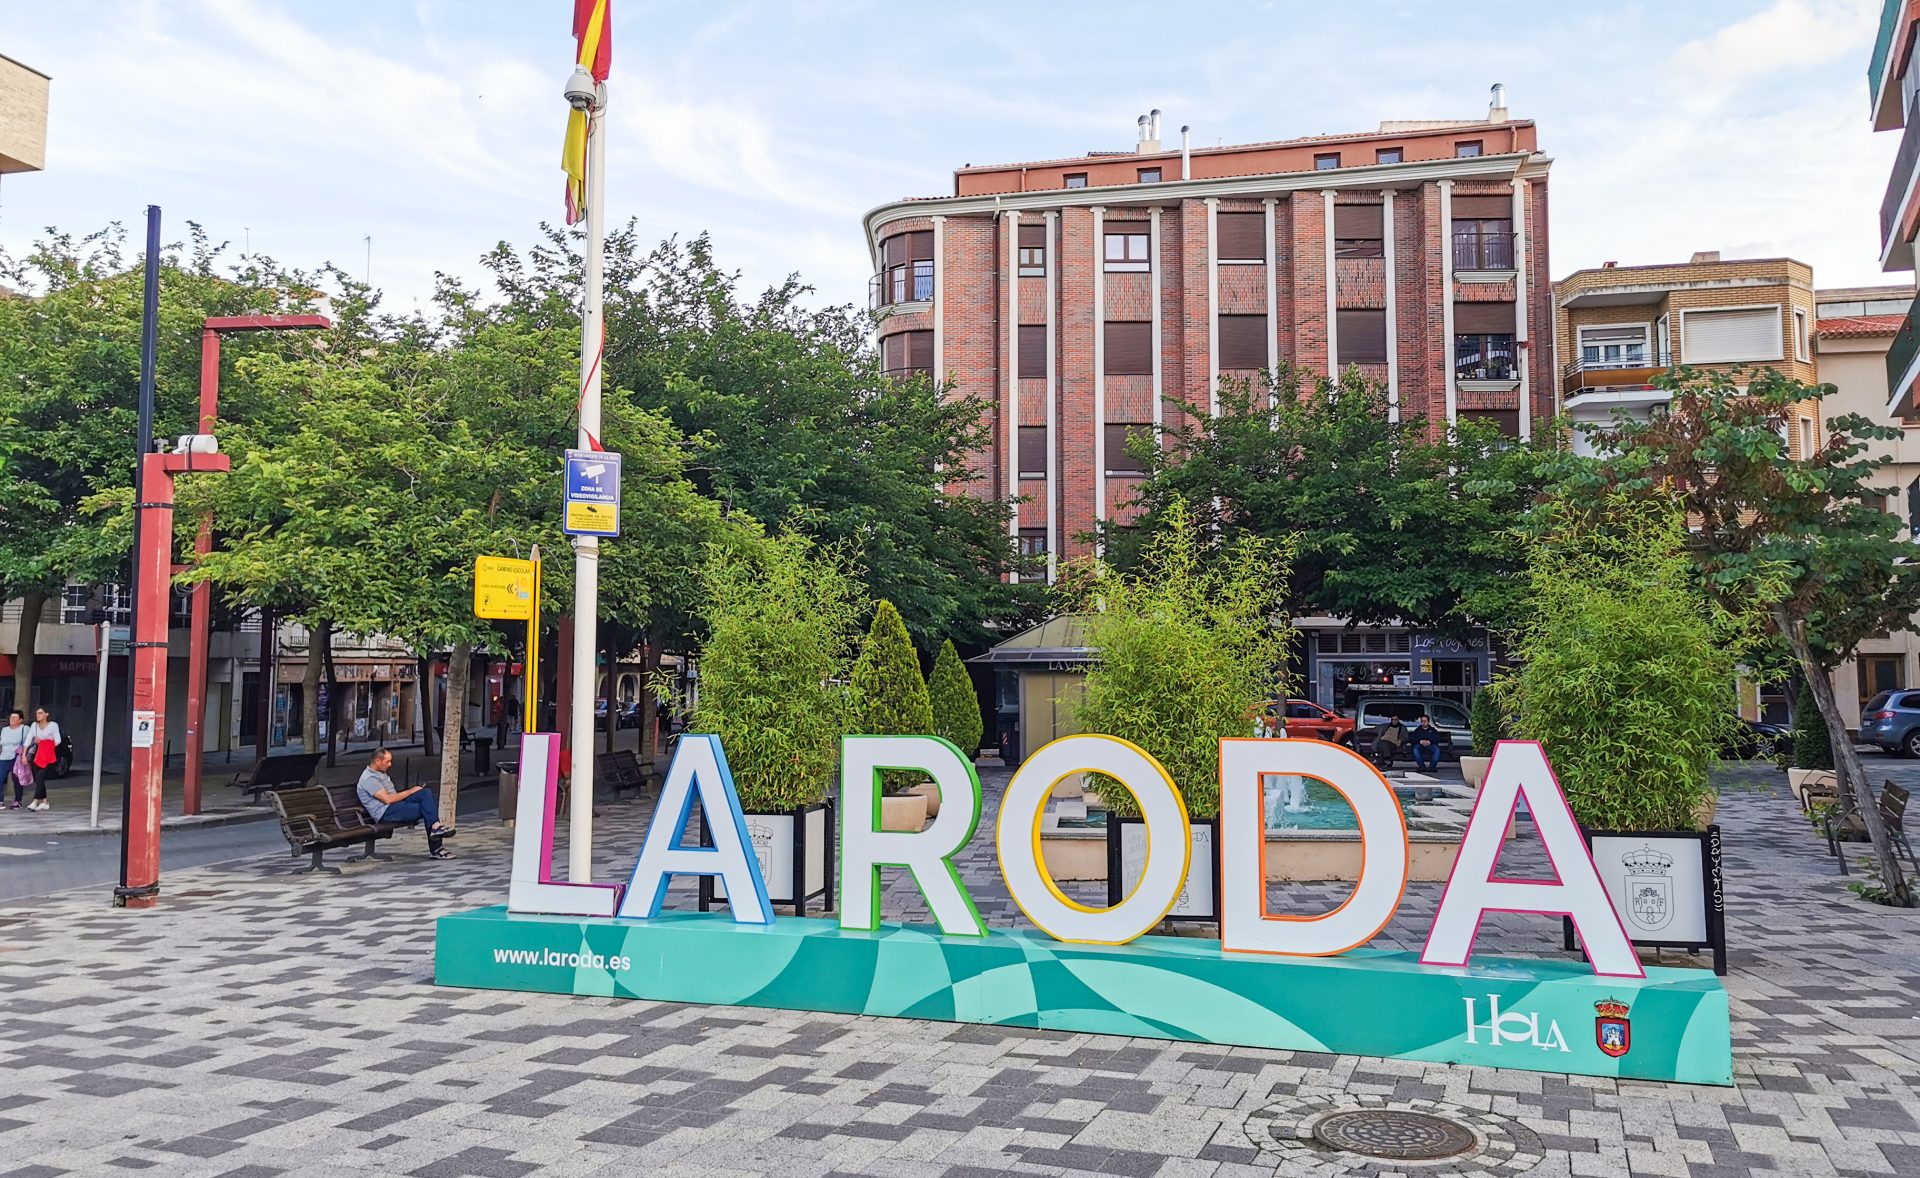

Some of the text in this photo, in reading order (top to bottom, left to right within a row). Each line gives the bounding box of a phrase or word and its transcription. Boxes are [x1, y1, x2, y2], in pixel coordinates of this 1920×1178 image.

[570, 492, 615, 501] VIDEOVIGILANCIA
[508, 732, 1647, 979] LA RODA
[493, 947, 632, 971] www.laroda.es
[1462, 993, 1573, 1053] HOLA
